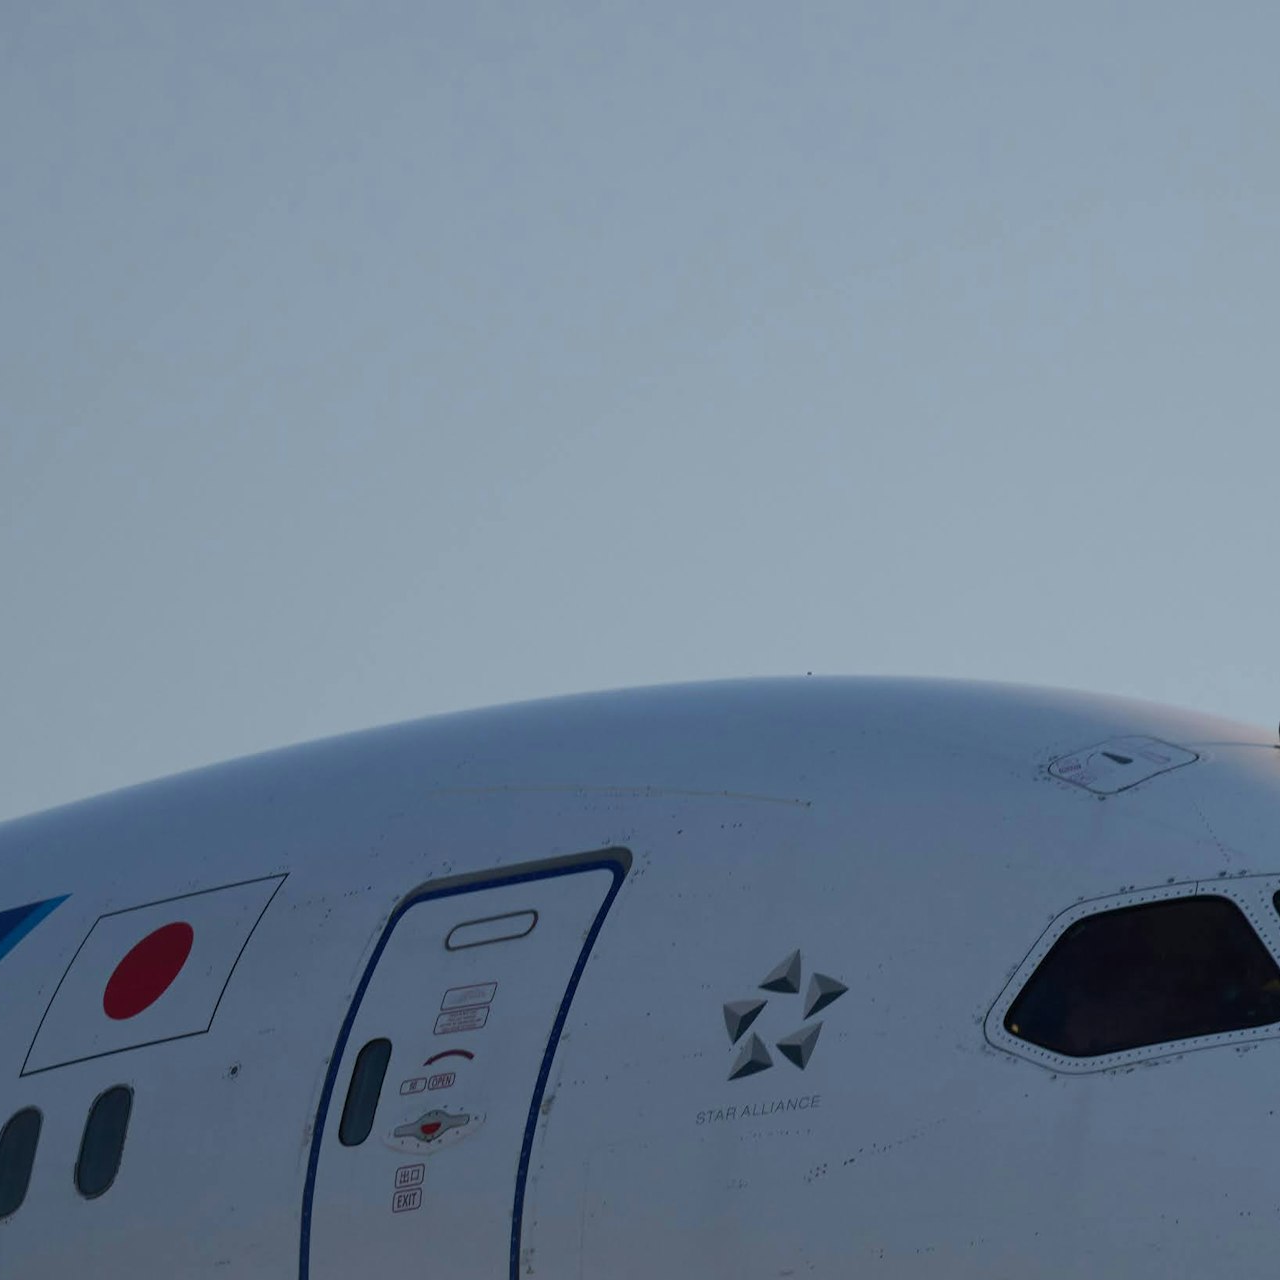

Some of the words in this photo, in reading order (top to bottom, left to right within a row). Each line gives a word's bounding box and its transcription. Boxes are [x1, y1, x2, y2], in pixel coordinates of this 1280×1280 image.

[696, 1106, 737, 1125] STAR
[741, 1095, 822, 1118] ALLIANCE
[399, 1169, 420, 1184] 出口
[397, 1192, 418, 1209] EXIT
